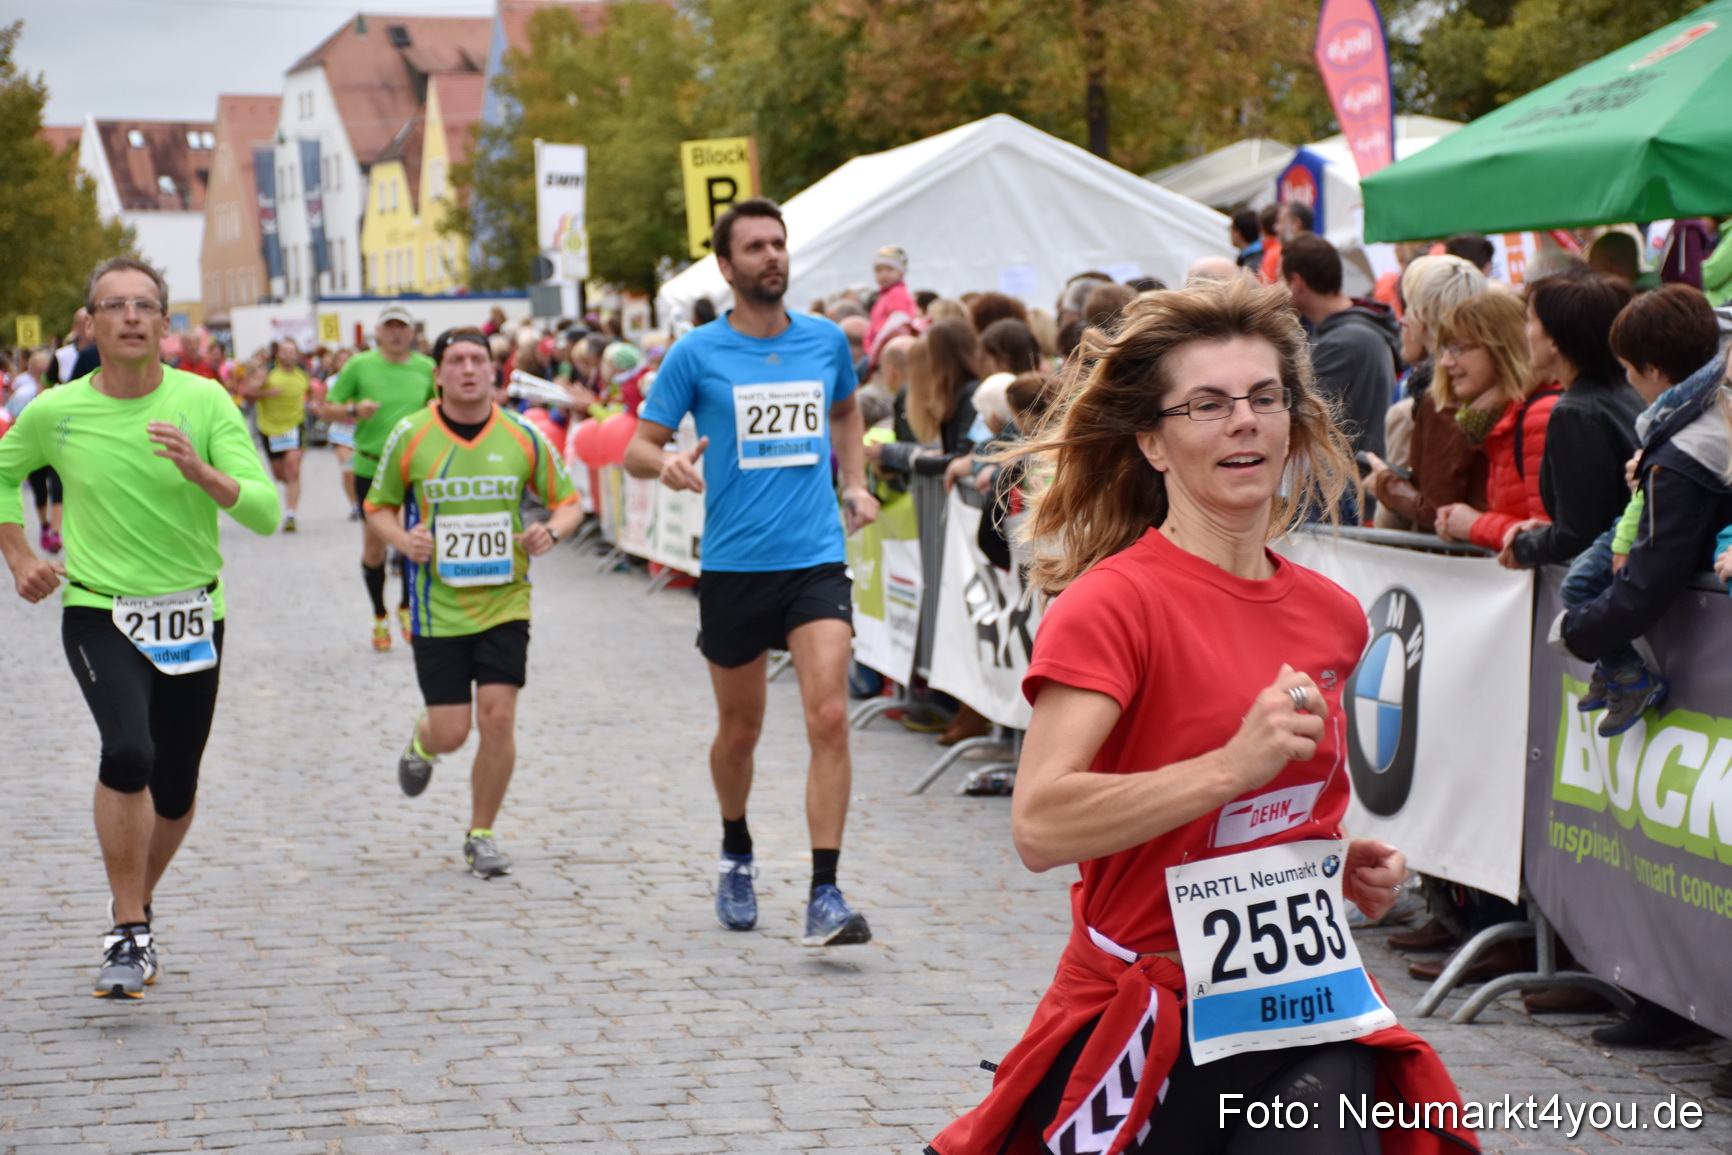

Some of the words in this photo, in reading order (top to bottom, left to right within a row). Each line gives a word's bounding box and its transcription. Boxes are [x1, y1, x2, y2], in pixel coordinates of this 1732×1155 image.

[747, 402, 818, 435] 2276
[758, 441, 812, 456] Bernhard
[422, 475, 519, 503] BOCK
[445, 530, 507, 558] 2709
[454, 564, 500, 577] Christian
[125, 607, 205, 642] 2105
[153, 649, 191, 663] udwig
[1249, 798, 1293, 829] DEHN
[1550, 810, 1621, 869] inspired
[1634, 854, 1677, 898] smart
[1175, 876, 1247, 904] PARTL
[1250, 861, 1318, 890] Neumarkt
[1202, 888, 1347, 985] 2553
[1260, 986, 1335, 1024] Birgit
